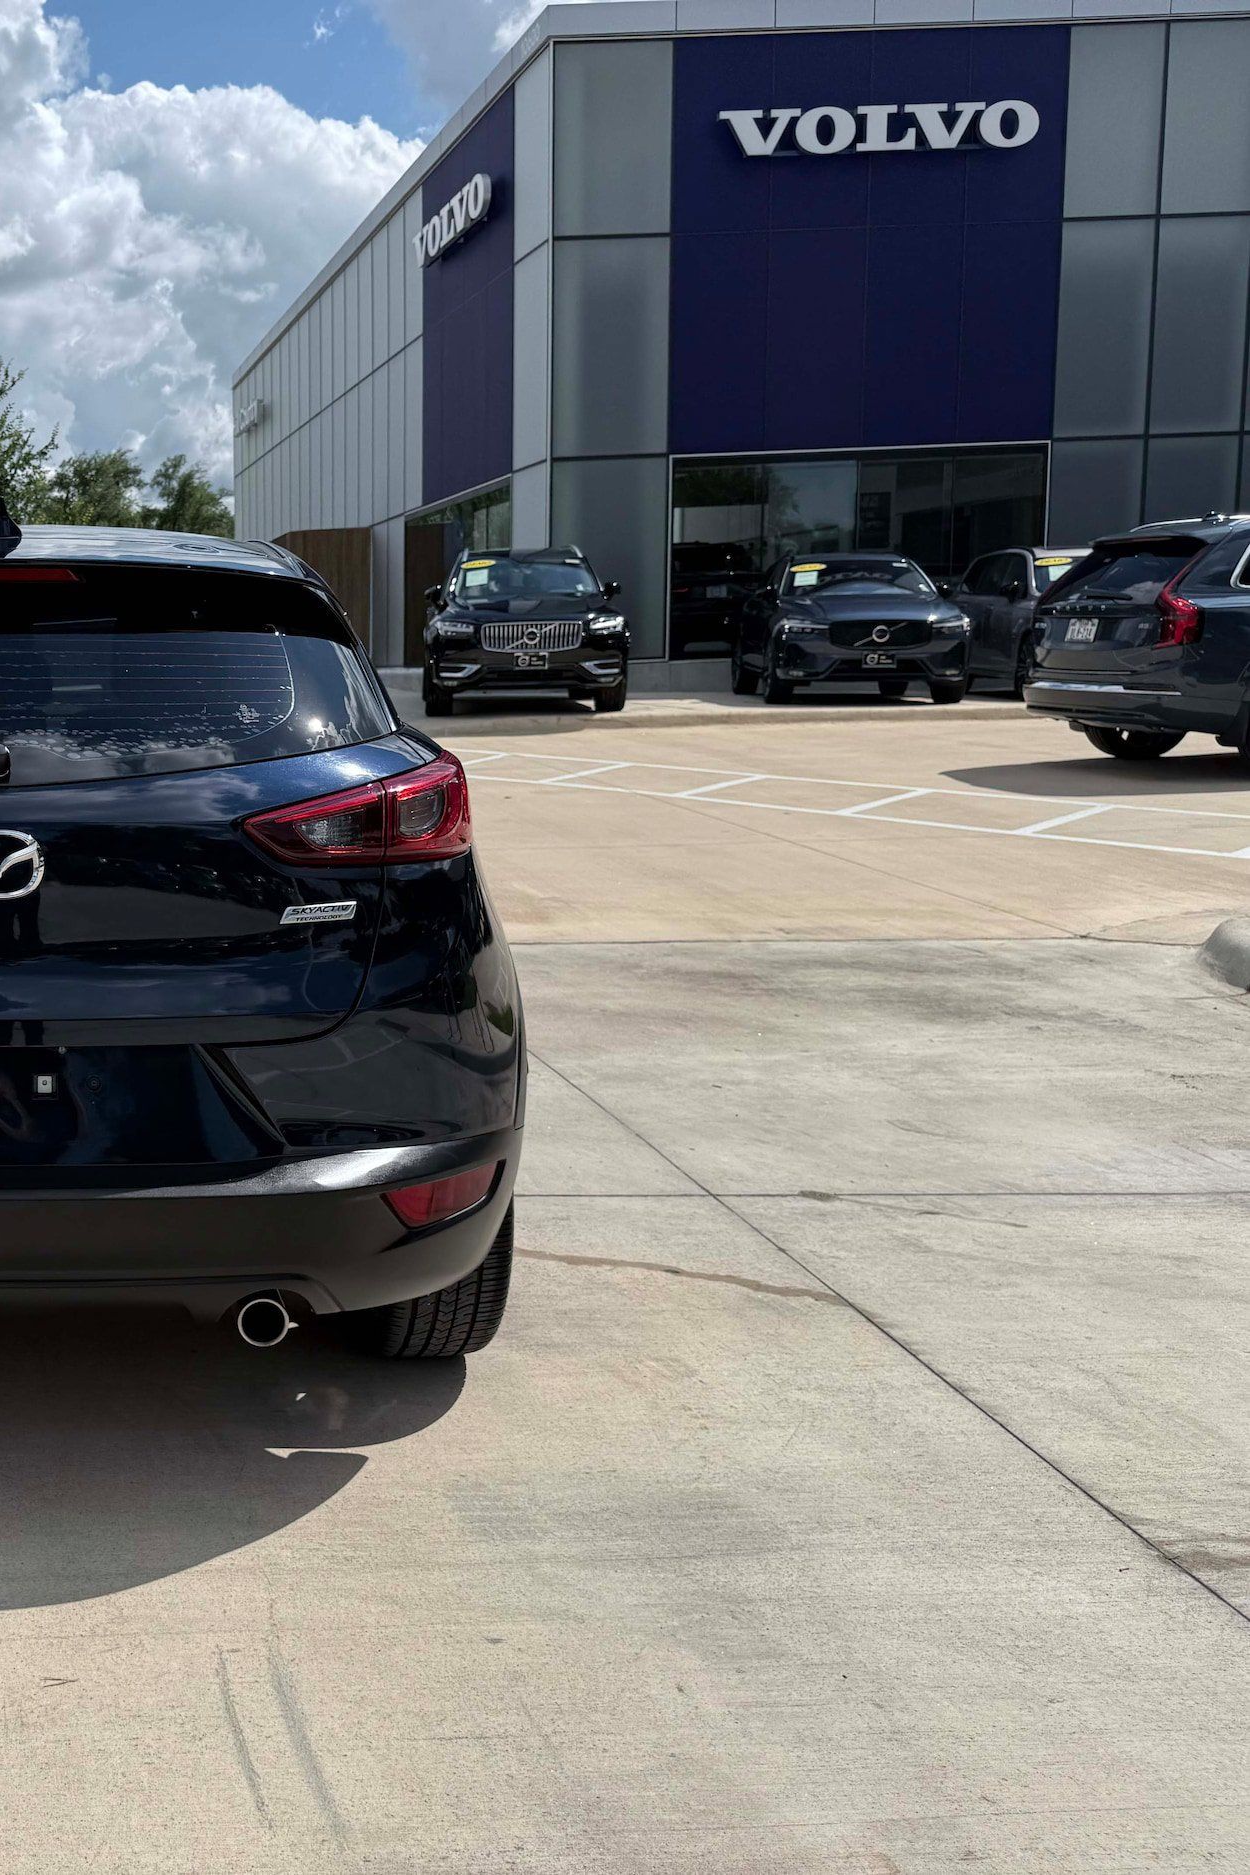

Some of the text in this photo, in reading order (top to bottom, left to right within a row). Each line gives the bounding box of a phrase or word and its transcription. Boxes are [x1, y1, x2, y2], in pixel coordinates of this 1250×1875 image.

[718, 99, 1040, 157] VOLVO
[412, 173, 489, 268] VOLVO
[290, 904, 351, 915] SKYACTIV
[295, 914, 342, 922] TECHNOLOGY
